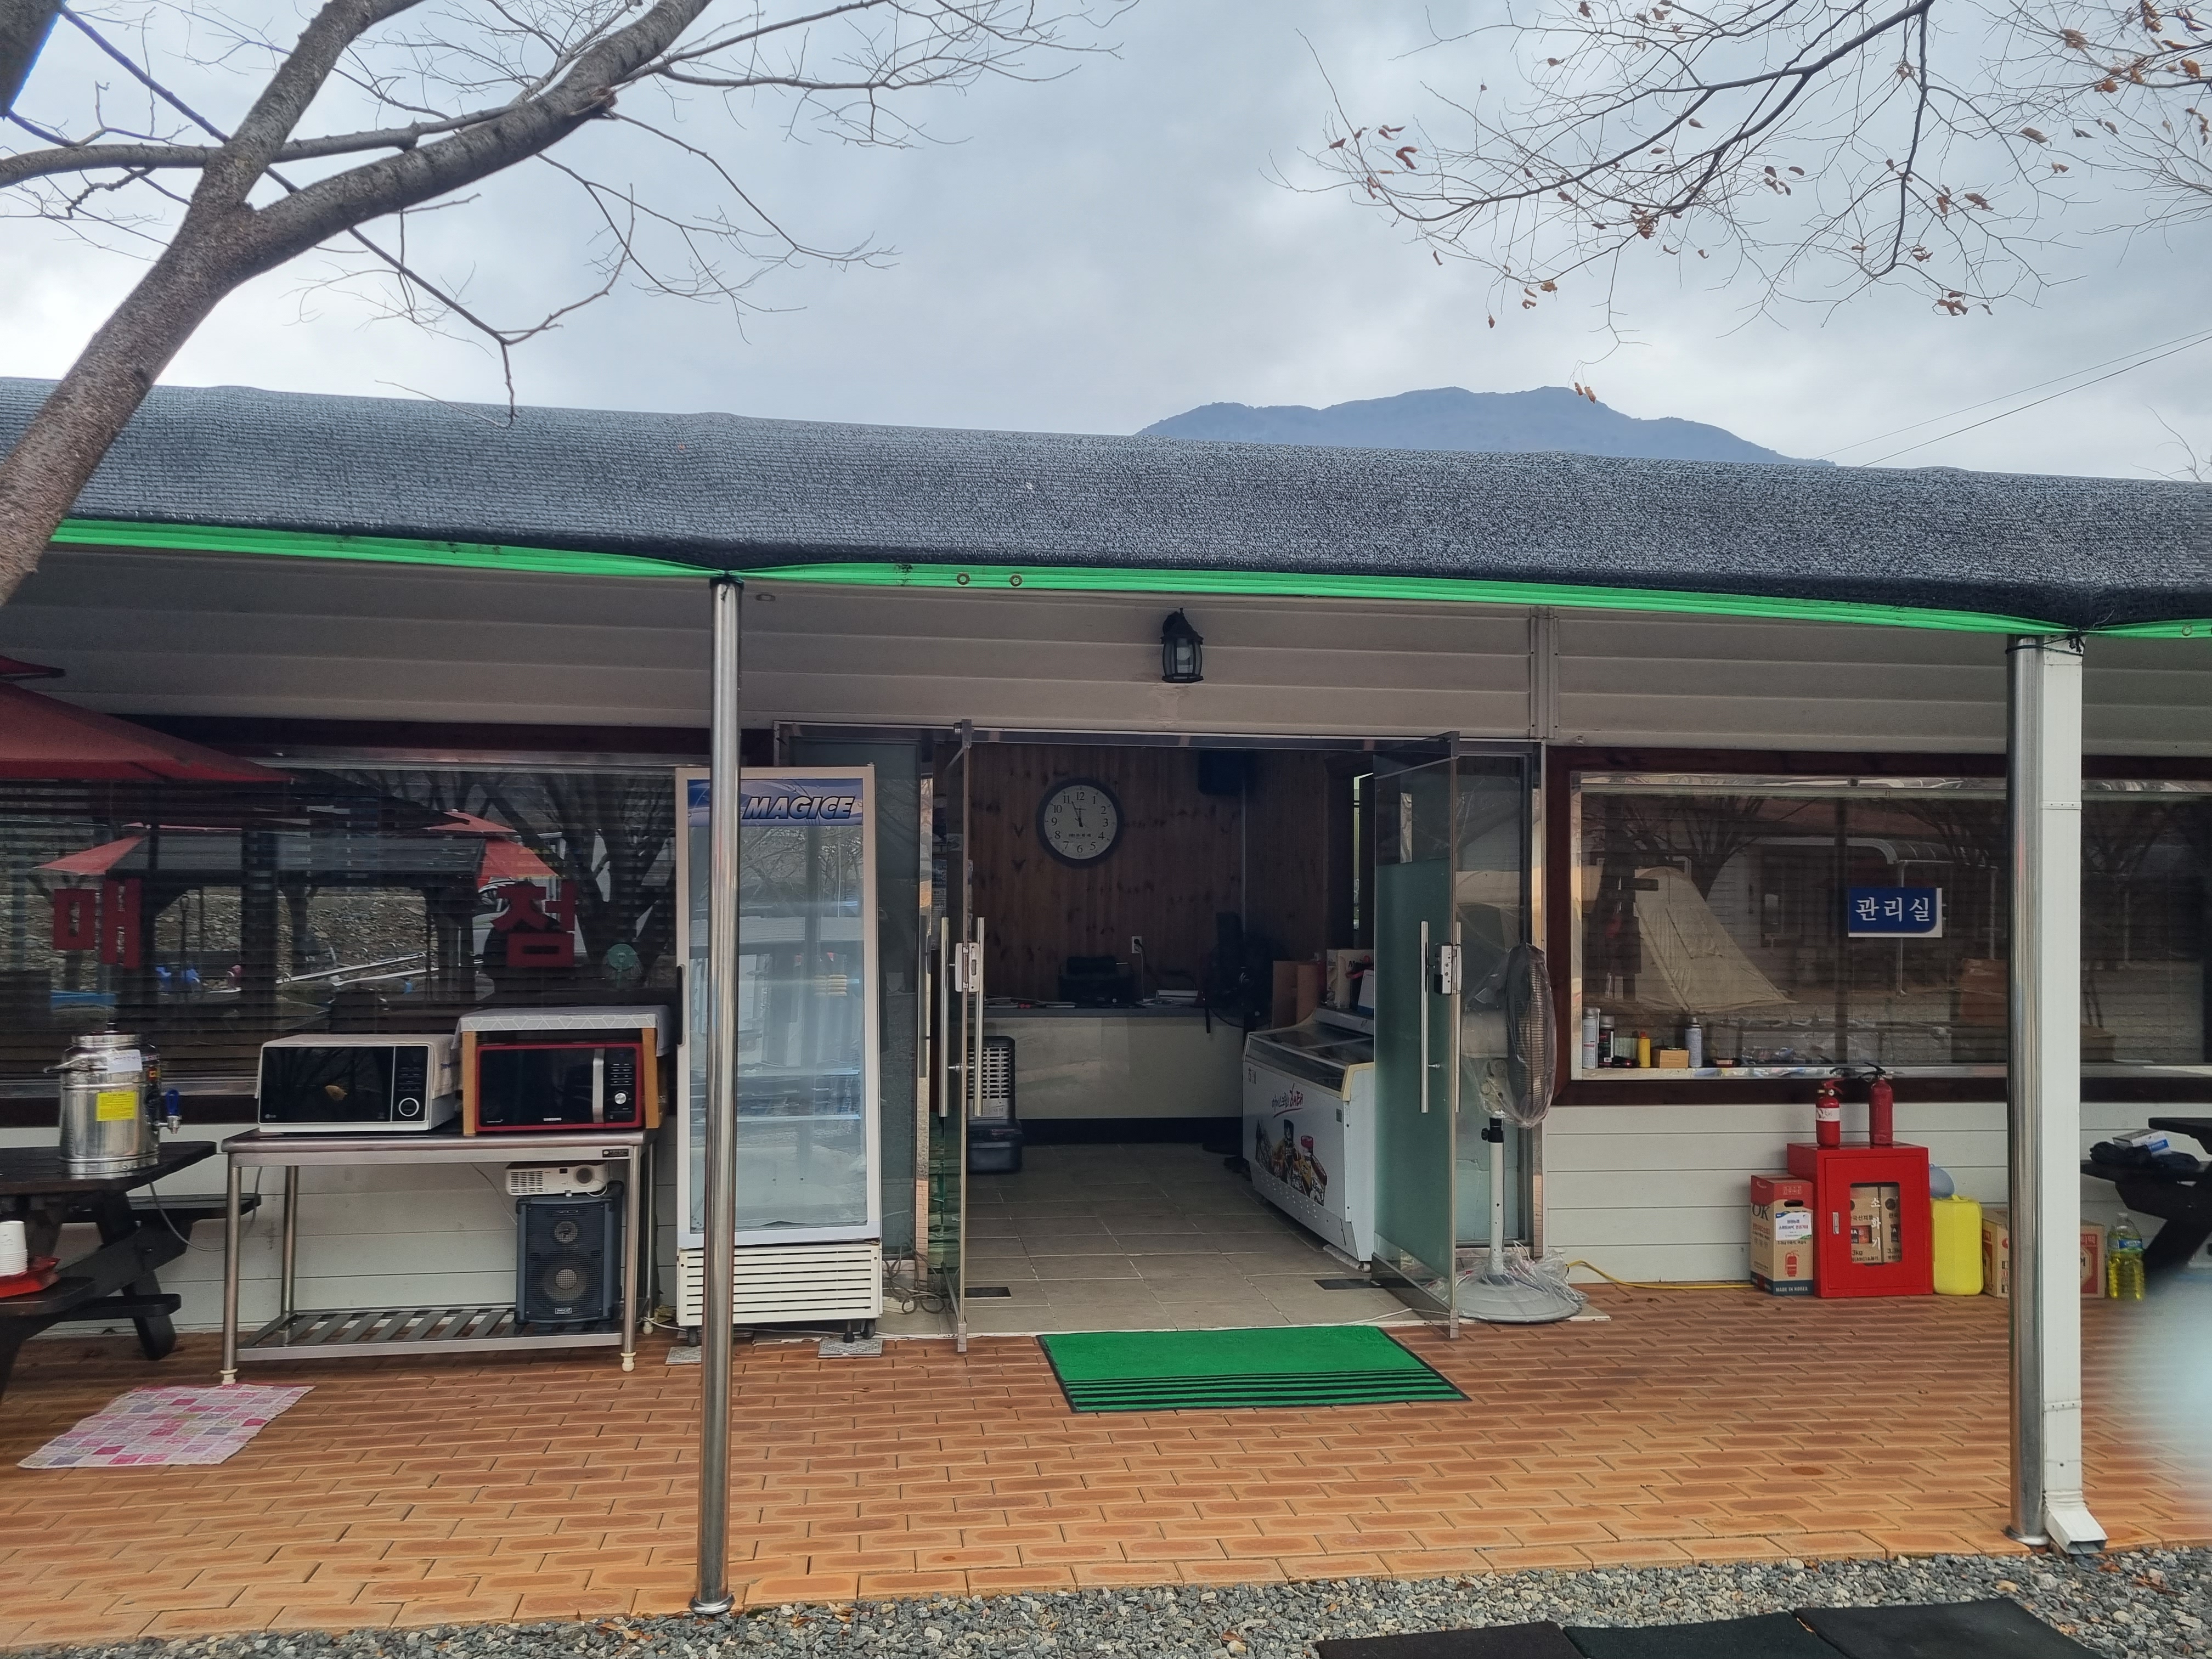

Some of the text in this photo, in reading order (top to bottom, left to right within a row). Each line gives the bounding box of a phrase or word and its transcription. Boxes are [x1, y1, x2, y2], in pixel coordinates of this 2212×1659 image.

[1063, 795, 1070, 804] 11
[1076, 792, 1085, 800] 12
[1092, 795, 1096, 804] 1
[741, 795, 856, 820] MAGICE
[1053, 804, 1063, 814] 10
[1101, 806, 1107, 814] 2
[1051, 817, 1058, 826] 9
[1103, 818, 1109, 827] 3
[1054, 830, 1061, 839] 8
[1098, 831, 1105, 840] 4
[1063, 840, 1069, 849] 7
[1077, 844, 1083, 853] 6
[1090, 842, 1096, 850] 5
[1855, 896, 1930, 922] 관리실
[53, 878, 579, 969] 매 점
[1752, 1202, 1770, 1221] OK
